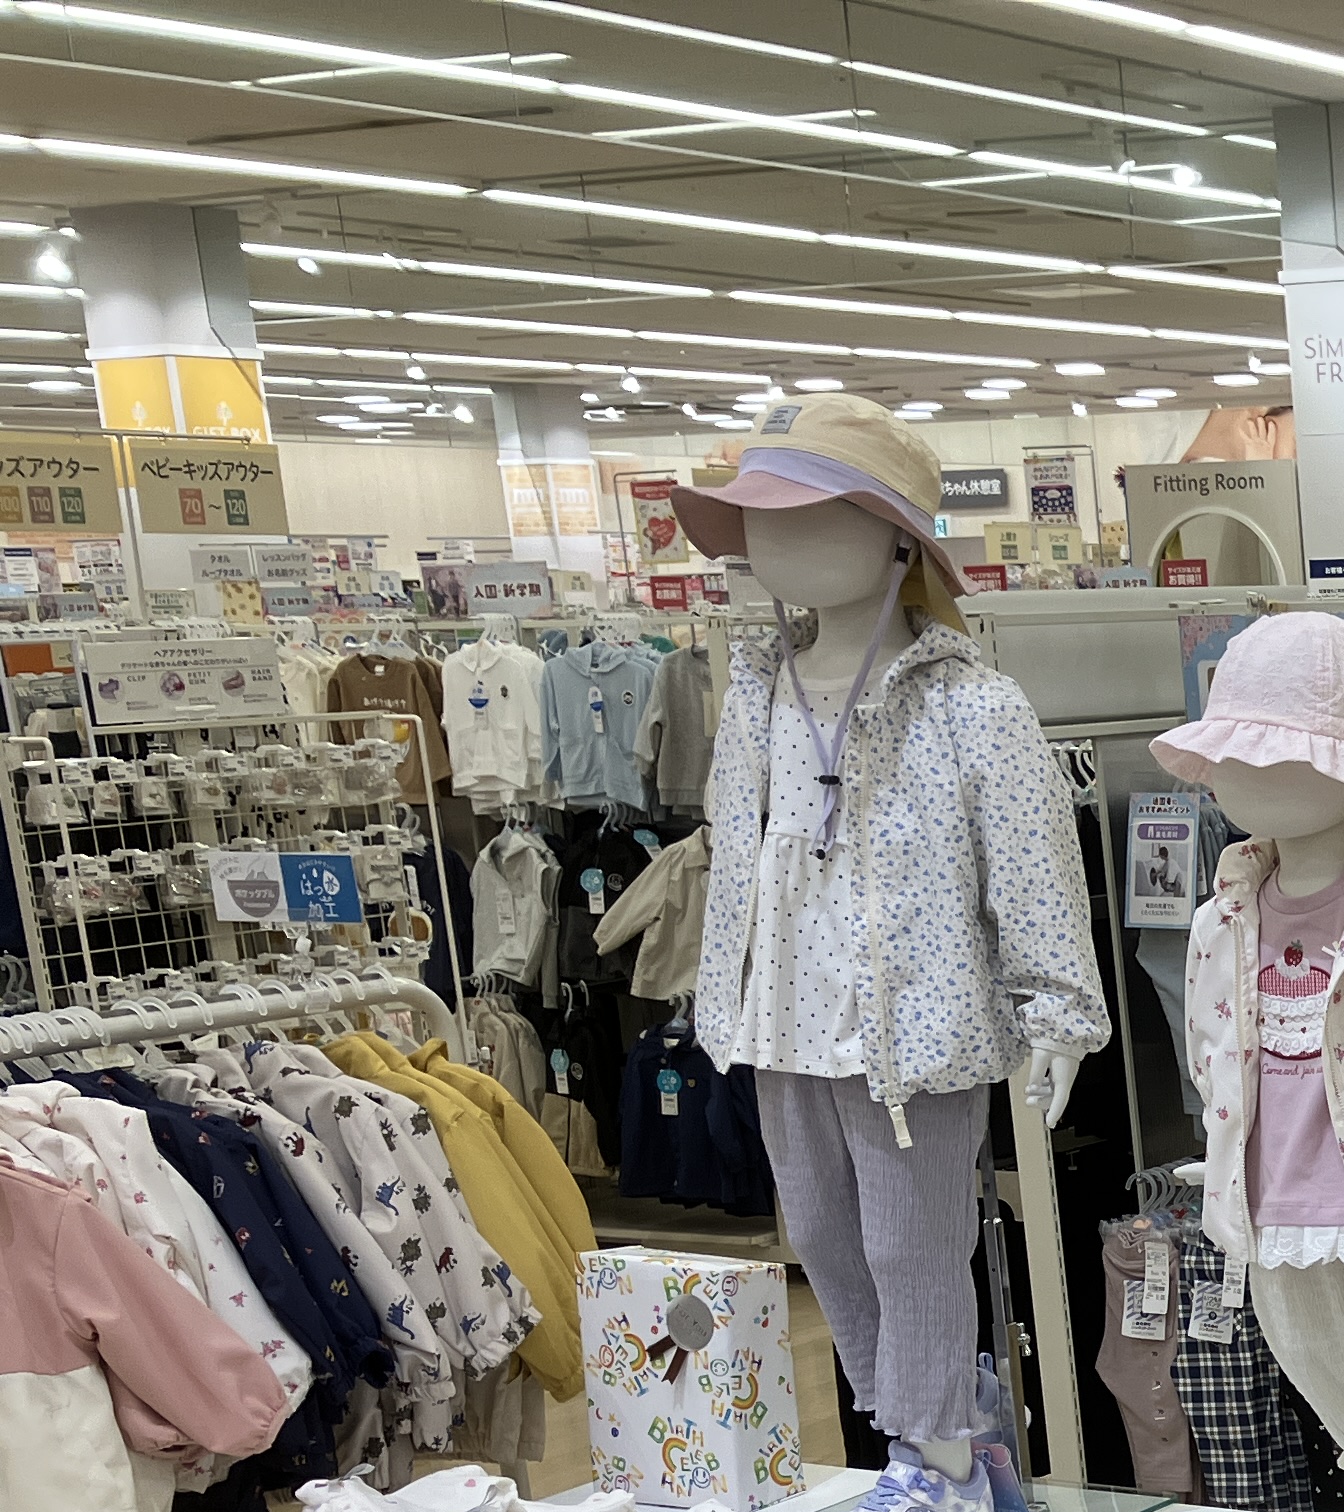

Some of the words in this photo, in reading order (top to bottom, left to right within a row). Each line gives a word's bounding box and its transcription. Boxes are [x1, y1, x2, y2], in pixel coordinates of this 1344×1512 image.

[141, 457, 273, 482] ベビーキッズアウター
[1153, 472, 1209, 495] Fitting
[1215, 472, 1265, 490] Room
[32, 497, 50, 512] 110
[63, 497, 82, 512] 120
[184, 498, 201, 513] 70
[228, 498, 246, 514] 120
[308, 901, 339, 918] 加工
